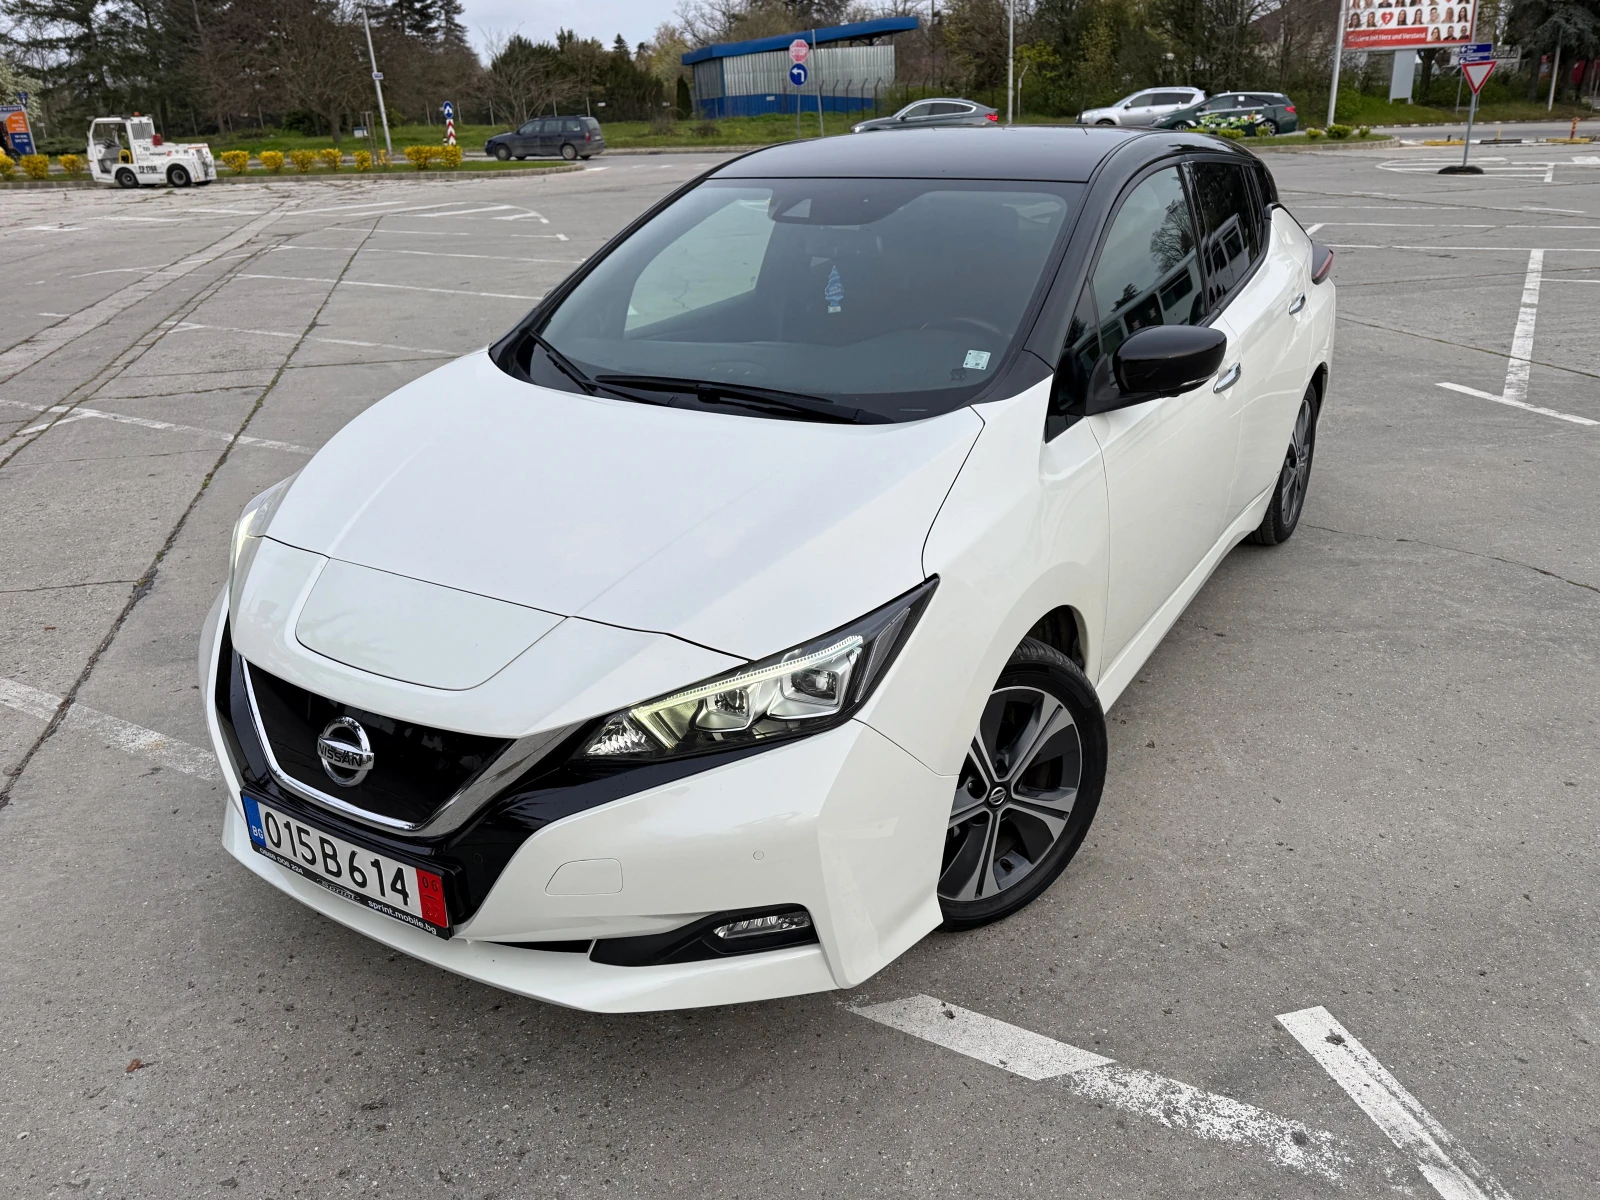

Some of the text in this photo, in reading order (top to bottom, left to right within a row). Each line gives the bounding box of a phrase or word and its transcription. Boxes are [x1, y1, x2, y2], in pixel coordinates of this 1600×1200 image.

[791, 47, 807, 55] STOP
[318, 743, 362, 767] NISSAN
[253, 825, 264, 840] BG
[264, 811, 410, 906] 015B614
[421, 876, 439, 892] 06
[368, 900, 437, 935] sprint.mobile.bg
